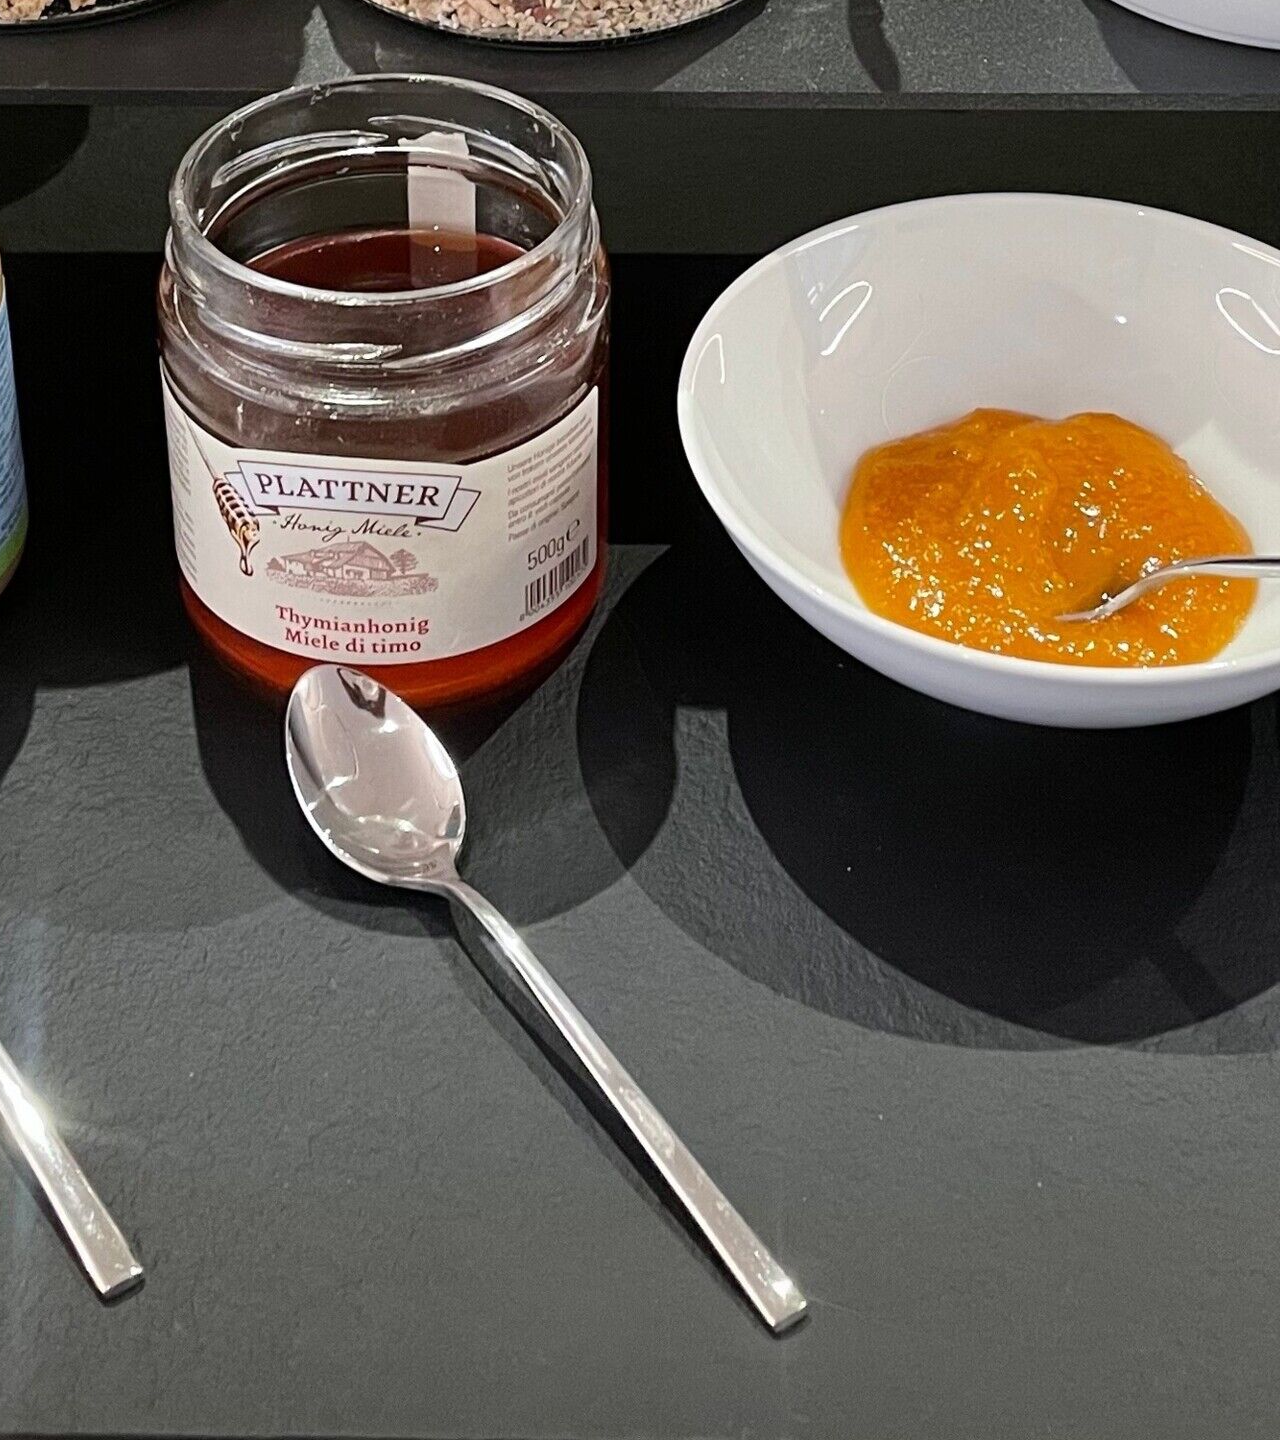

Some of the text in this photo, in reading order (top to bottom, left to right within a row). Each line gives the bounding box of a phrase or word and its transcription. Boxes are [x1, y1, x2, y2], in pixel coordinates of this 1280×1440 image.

[254, 472, 441, 507] PLATTNER
[280, 513, 413, 543] Honig Miele
[527, 537, 565, 571] 500g
[275, 604, 430, 634] Thymianhonig
[284, 627, 422, 654] Miele di timo
